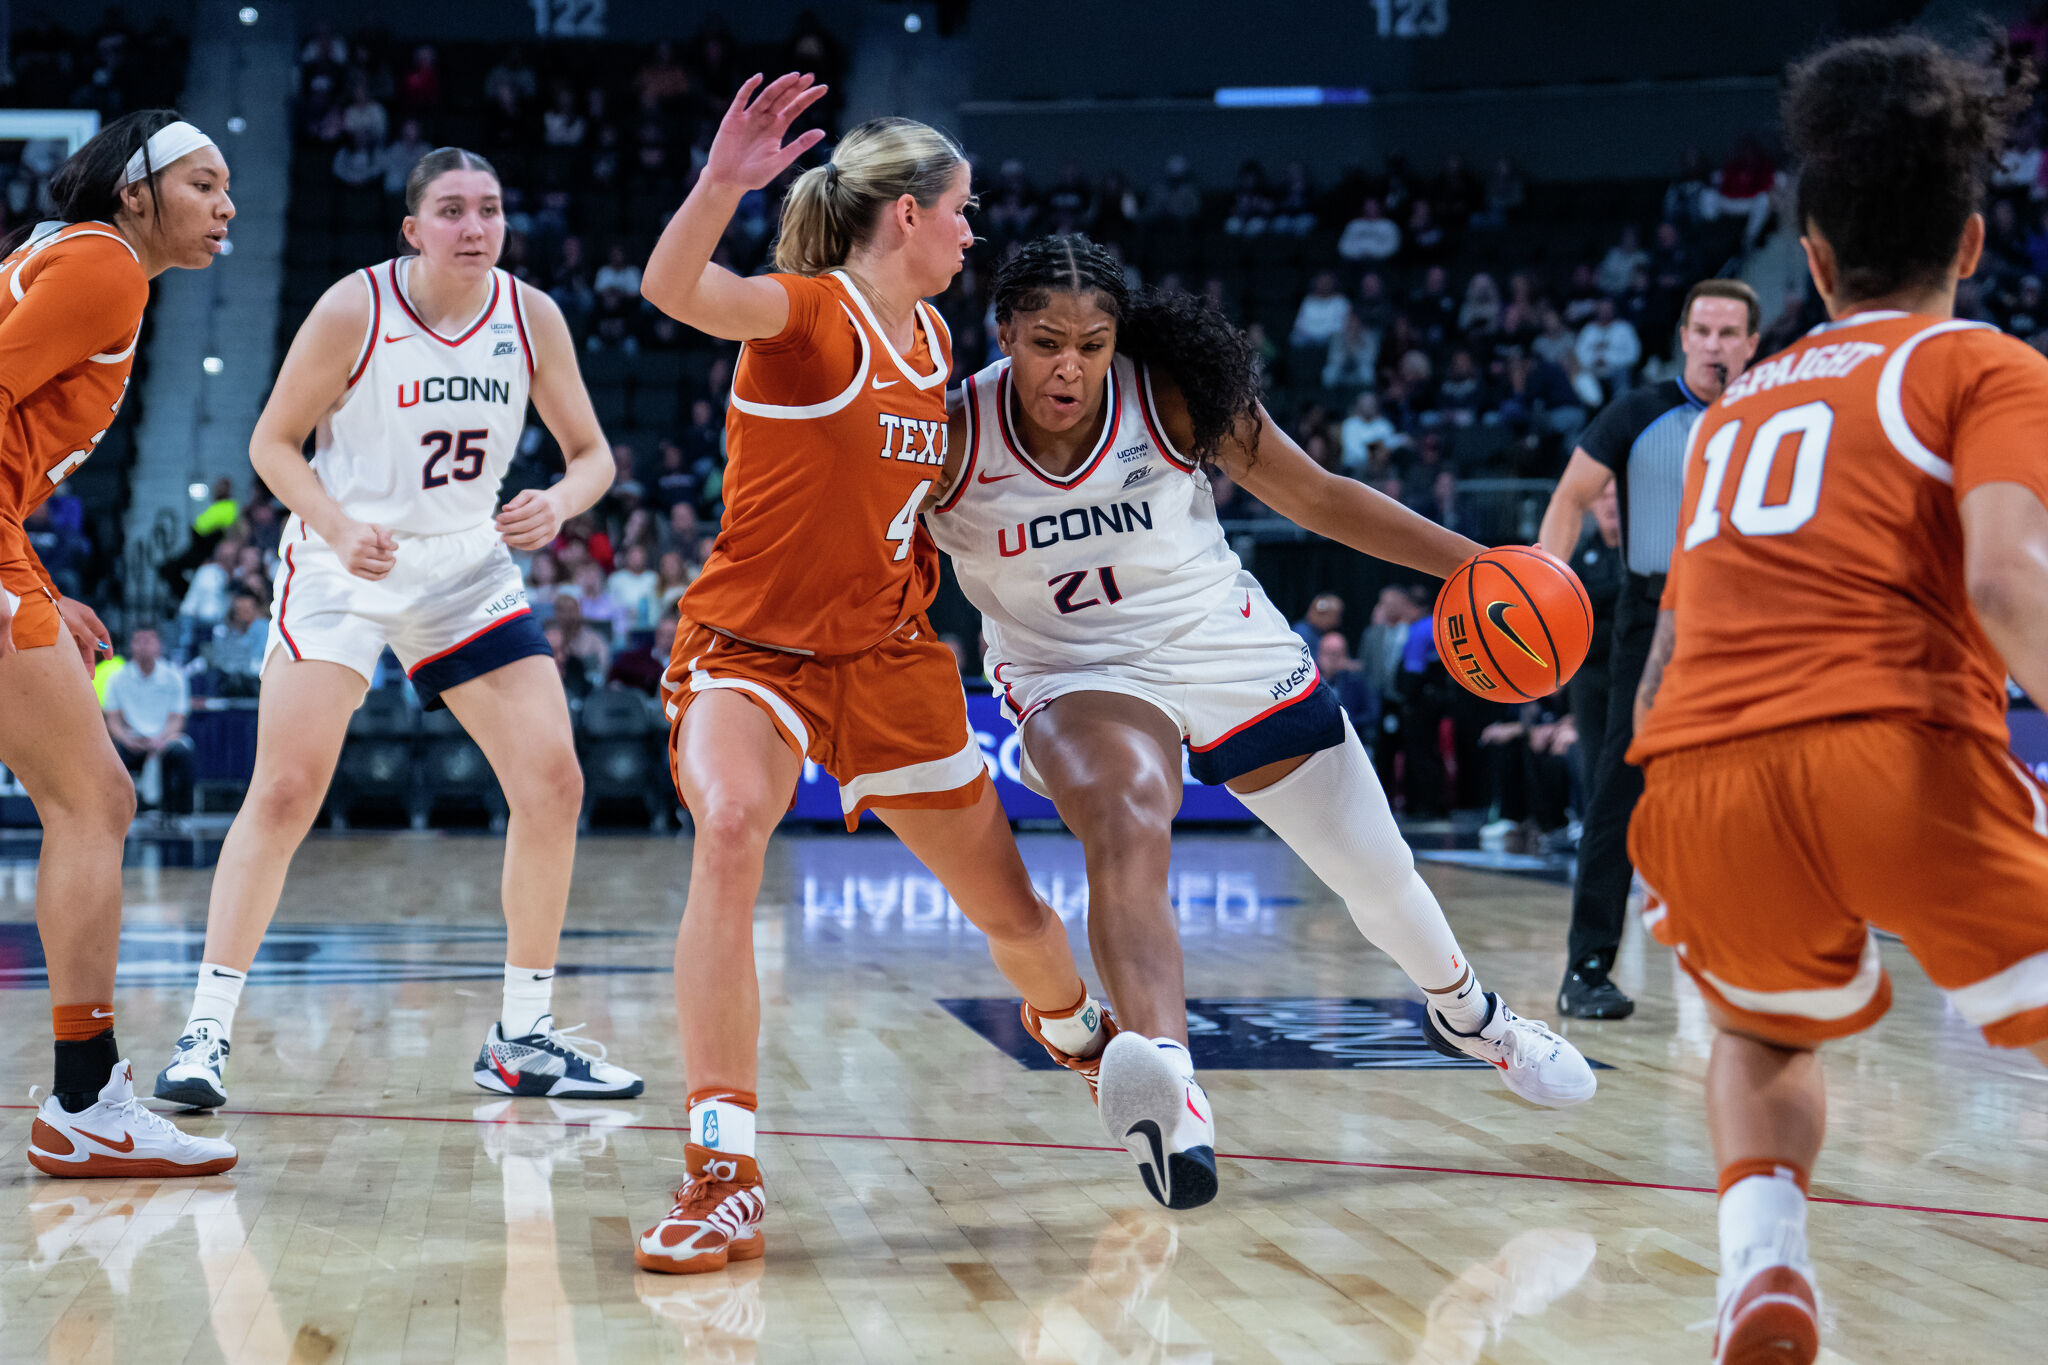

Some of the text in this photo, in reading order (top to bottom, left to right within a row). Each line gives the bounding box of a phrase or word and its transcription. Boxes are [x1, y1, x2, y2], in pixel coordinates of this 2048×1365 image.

[528, 0, 604, 36] 122
[1370, 0, 1449, 36] 123
[398, 375, 509, 408] UCONN
[1721, 341, 1885, 408] SPAIGHT
[420, 428, 489, 490] 25
[1117, 443, 1148, 458] UCONN
[1122, 452, 1147, 463] HEALTH
[1683, 400, 1835, 552] 10
[884, 479, 933, 562] 4
[998, 501, 1153, 557] UCONN
[1047, 565, 1123, 615] 21
[1448, 613, 1498, 691] ELITE
